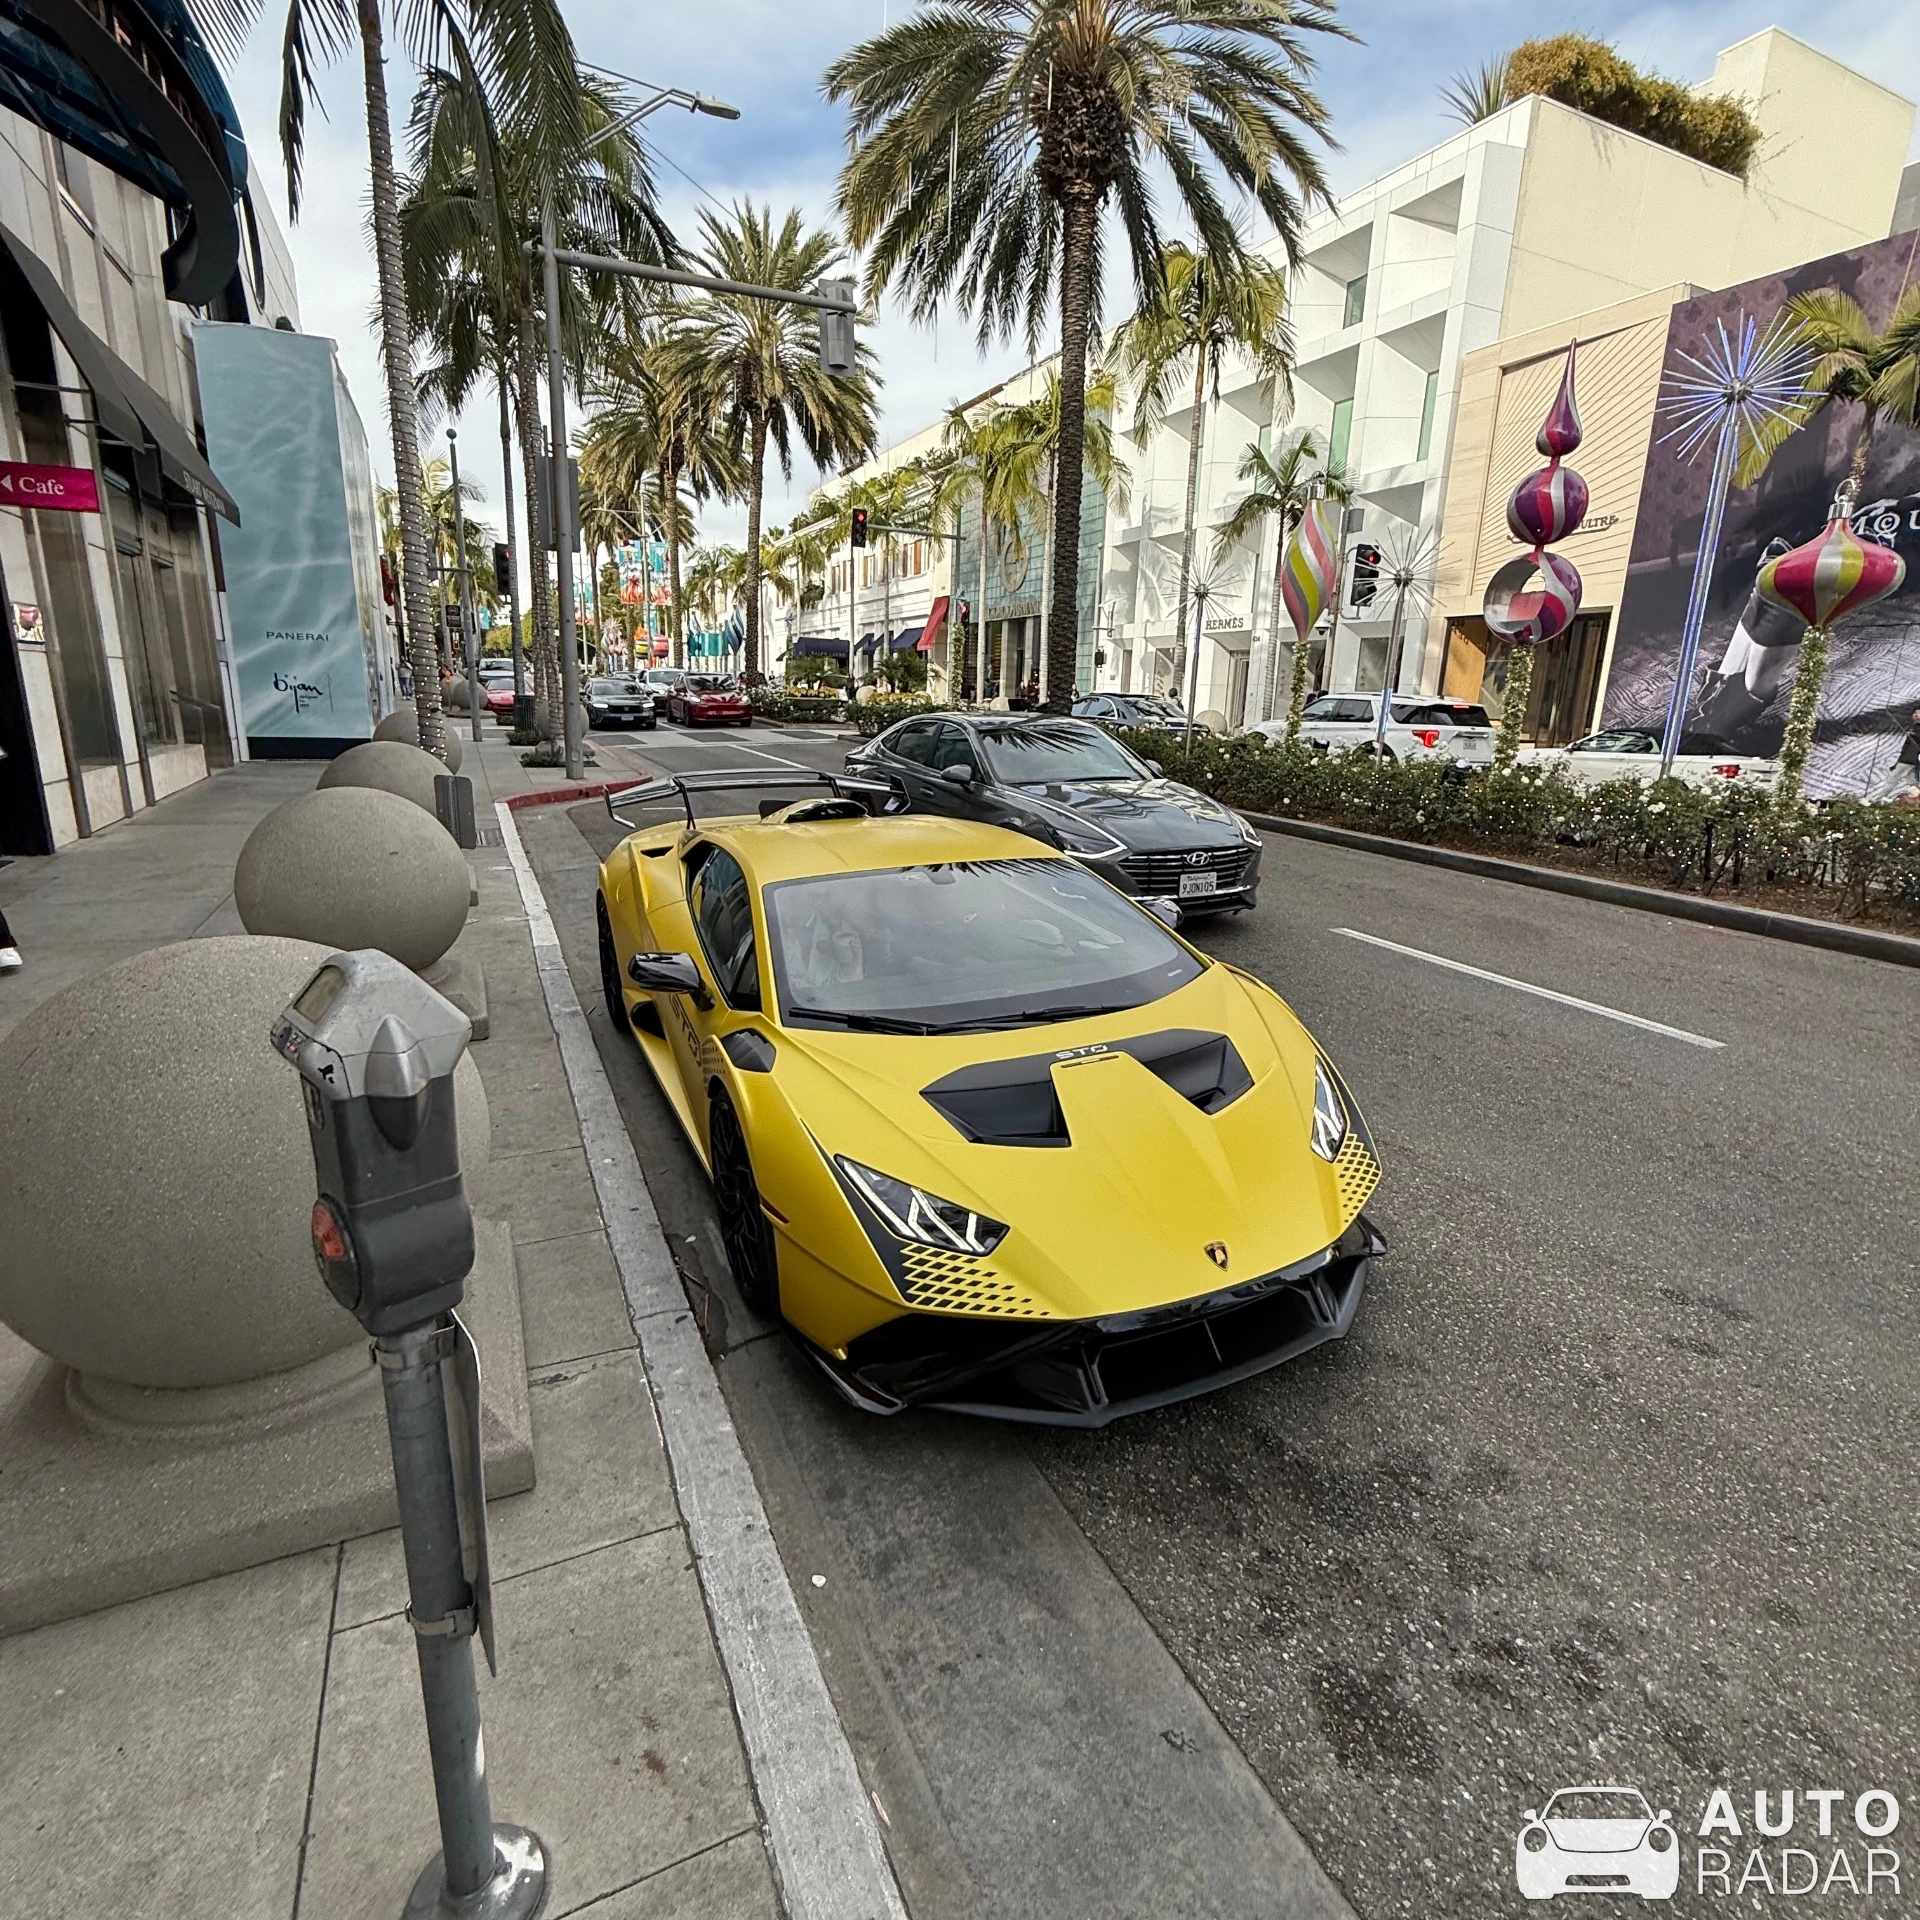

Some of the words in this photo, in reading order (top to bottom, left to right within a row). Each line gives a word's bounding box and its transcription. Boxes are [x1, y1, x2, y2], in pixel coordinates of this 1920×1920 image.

[19, 476, 65, 495] Cafe
[266, 631, 329, 642] PANERAI
[273, 672, 323, 714] bijan
[1055, 1044, 1108, 1060] STO
